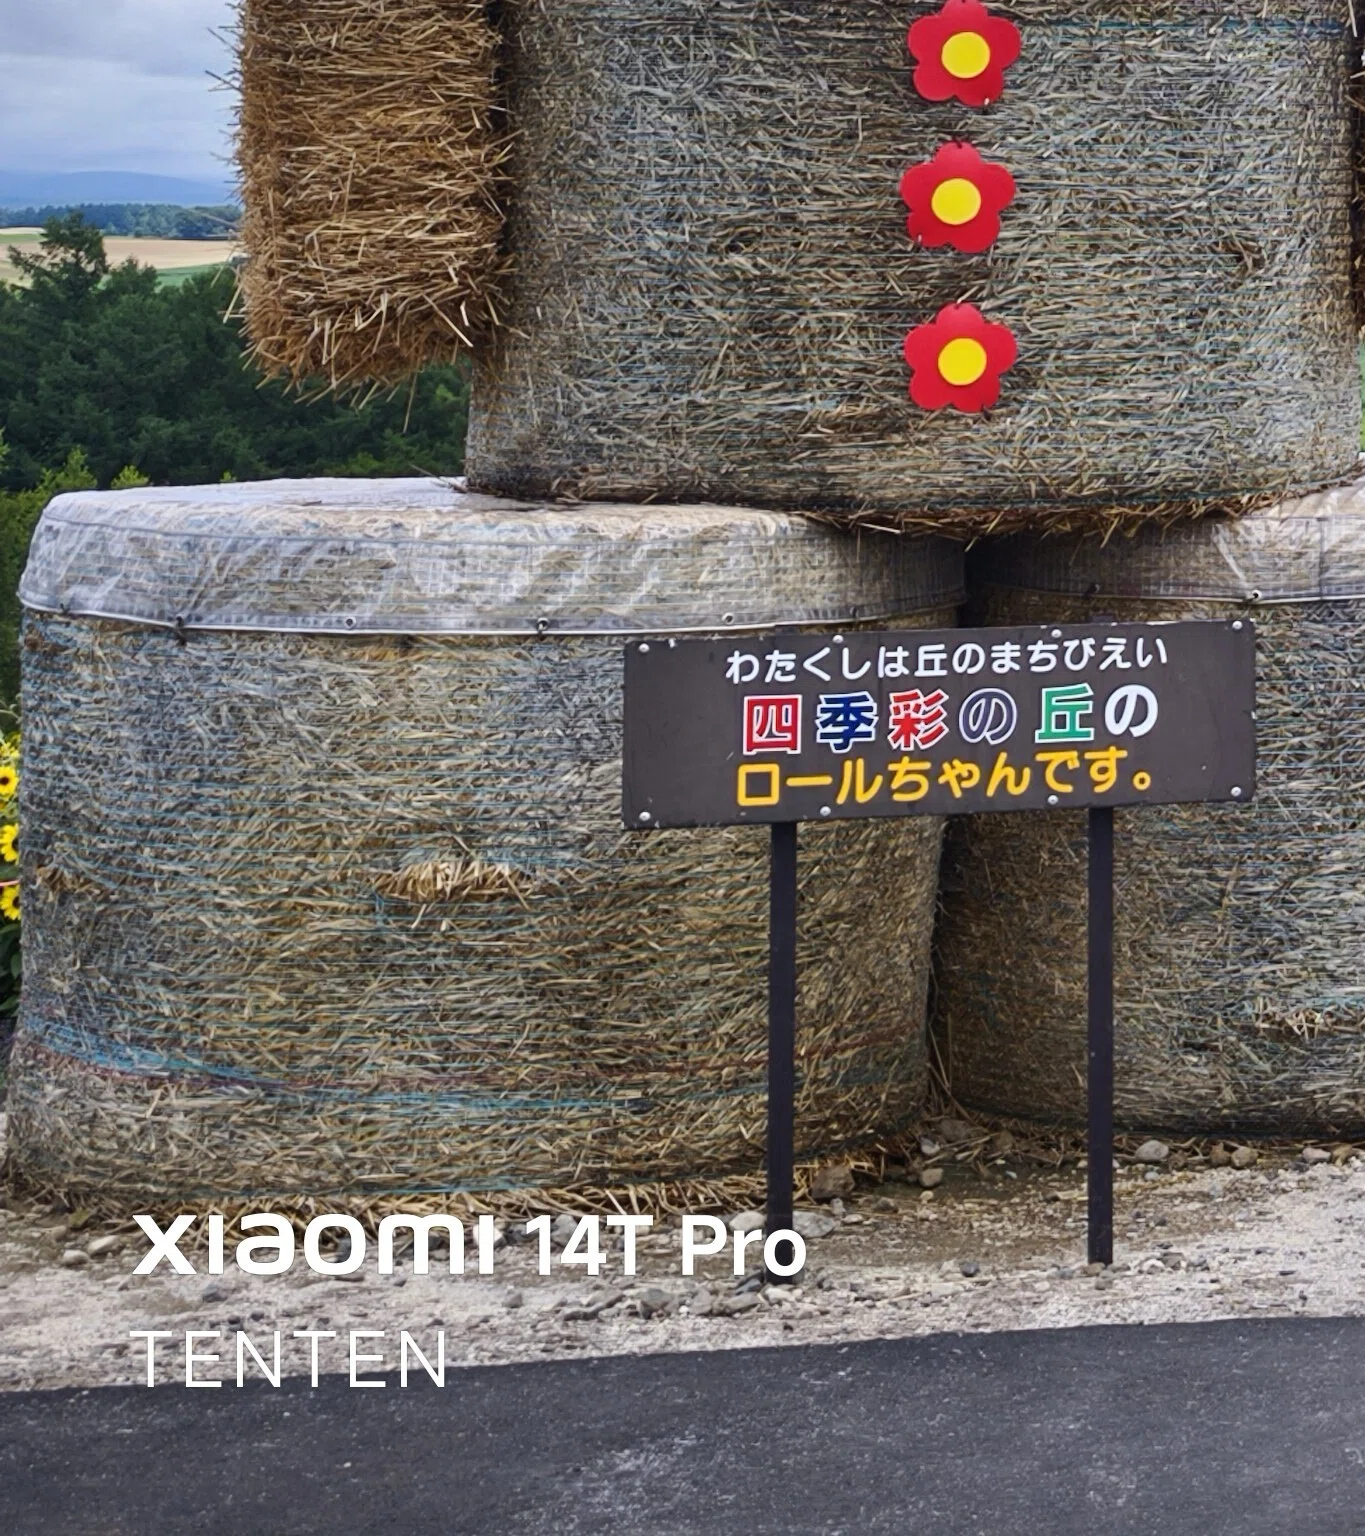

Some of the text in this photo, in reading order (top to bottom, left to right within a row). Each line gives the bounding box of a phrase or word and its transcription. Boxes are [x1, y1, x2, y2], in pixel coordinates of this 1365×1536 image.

[726, 636, 1168, 684] わたくしは丘のまちびえい
[741, 682, 1159, 754] 四季彩の丘の
[736, 745, 1152, 807] ロールちゃんです。
